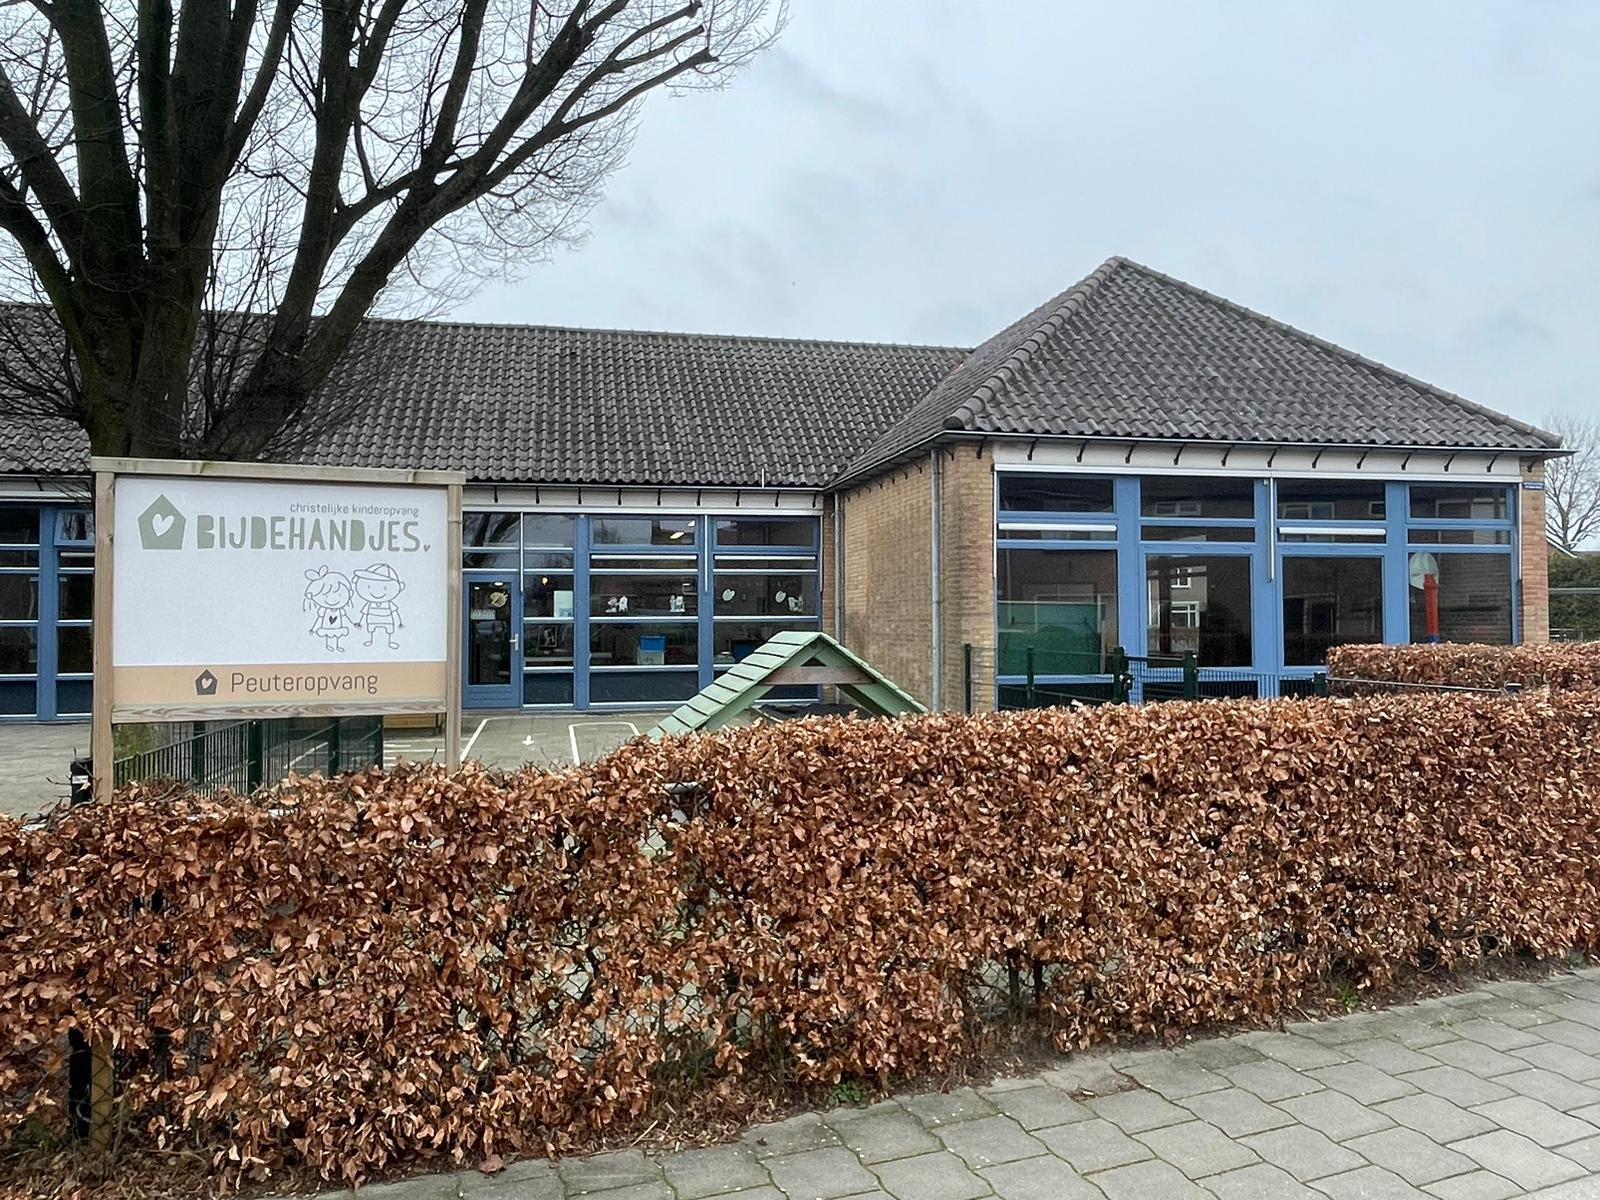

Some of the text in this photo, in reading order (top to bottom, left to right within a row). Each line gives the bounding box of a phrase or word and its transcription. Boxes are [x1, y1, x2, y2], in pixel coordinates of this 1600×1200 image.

[289, 503, 419, 517] christelijke kinderopvang
[231, 672, 378, 696] Peuteropvang
